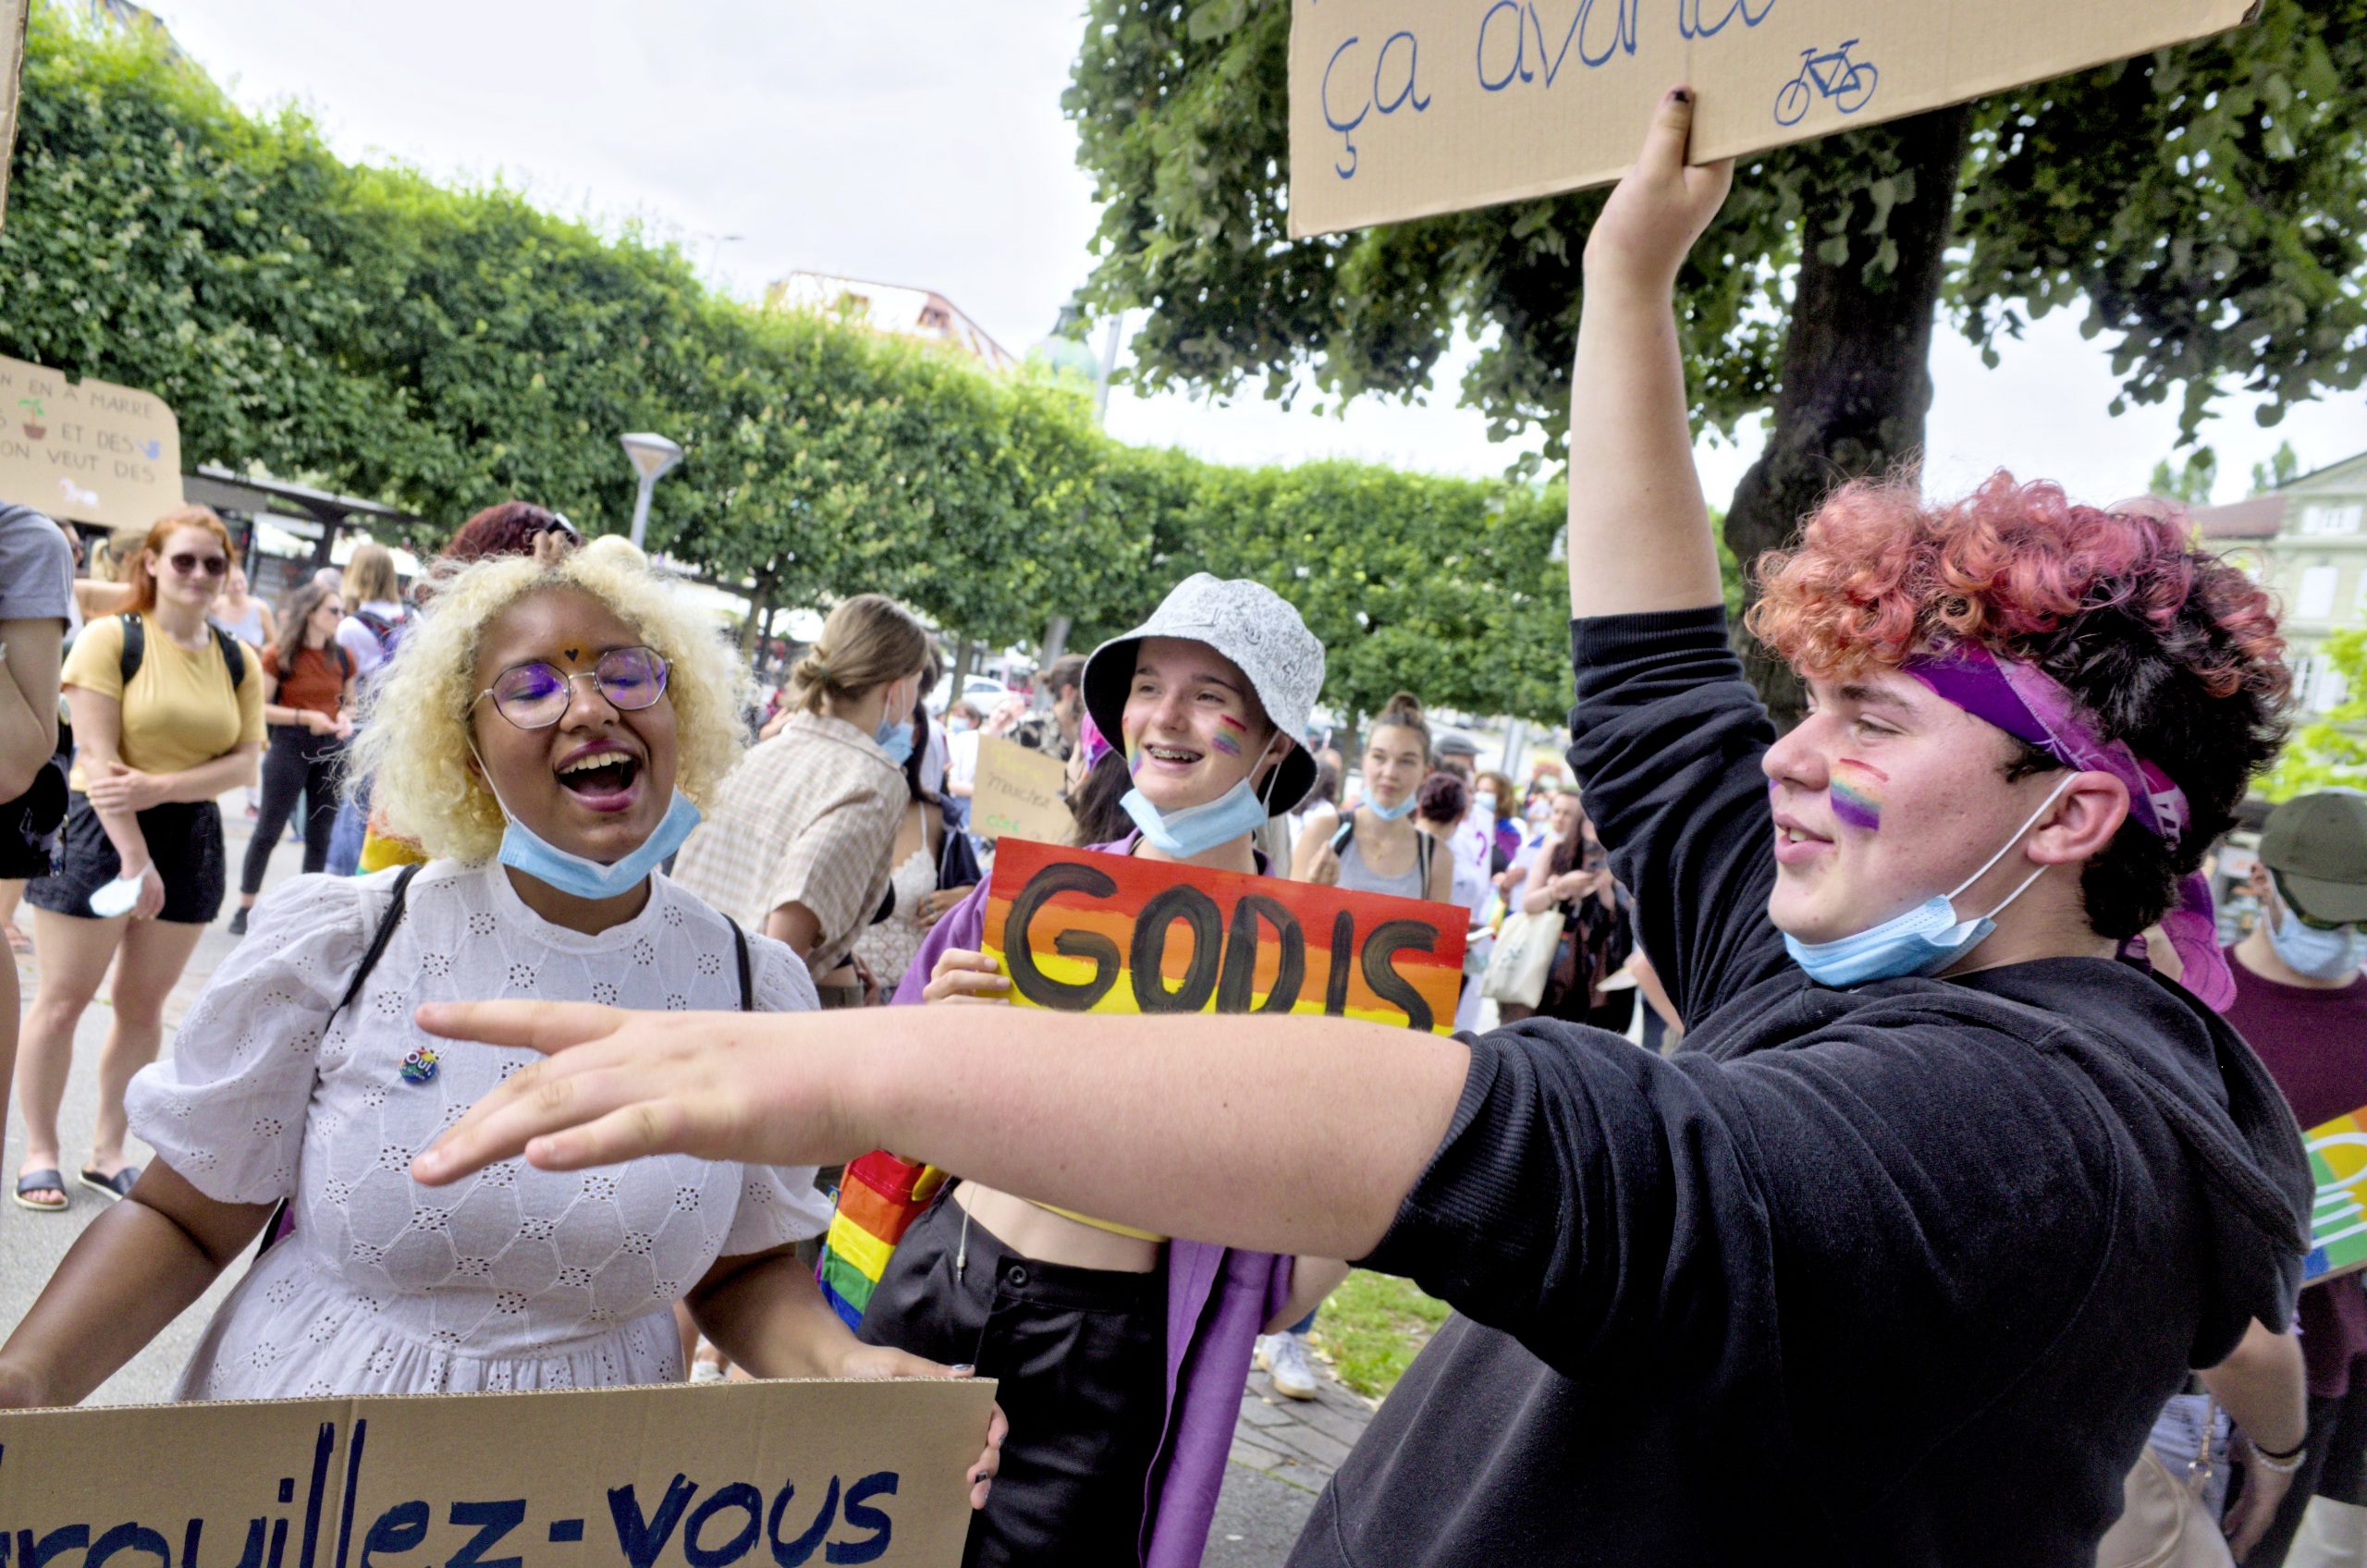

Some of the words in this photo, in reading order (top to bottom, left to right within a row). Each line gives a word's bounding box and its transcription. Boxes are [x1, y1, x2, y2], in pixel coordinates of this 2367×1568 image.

[1321, 30, 1432, 180] ça
[29, 378, 52, 398] EN
[90, 393, 152, 419] MARRE
[62, 422, 84, 443] ET
[97, 428, 134, 454] DES
[1, 440, 30, 460] ON
[46, 447, 100, 471] VEUT
[114, 459, 156, 484] DES
[0, 1419, 899, 1568] rouillez-vous
